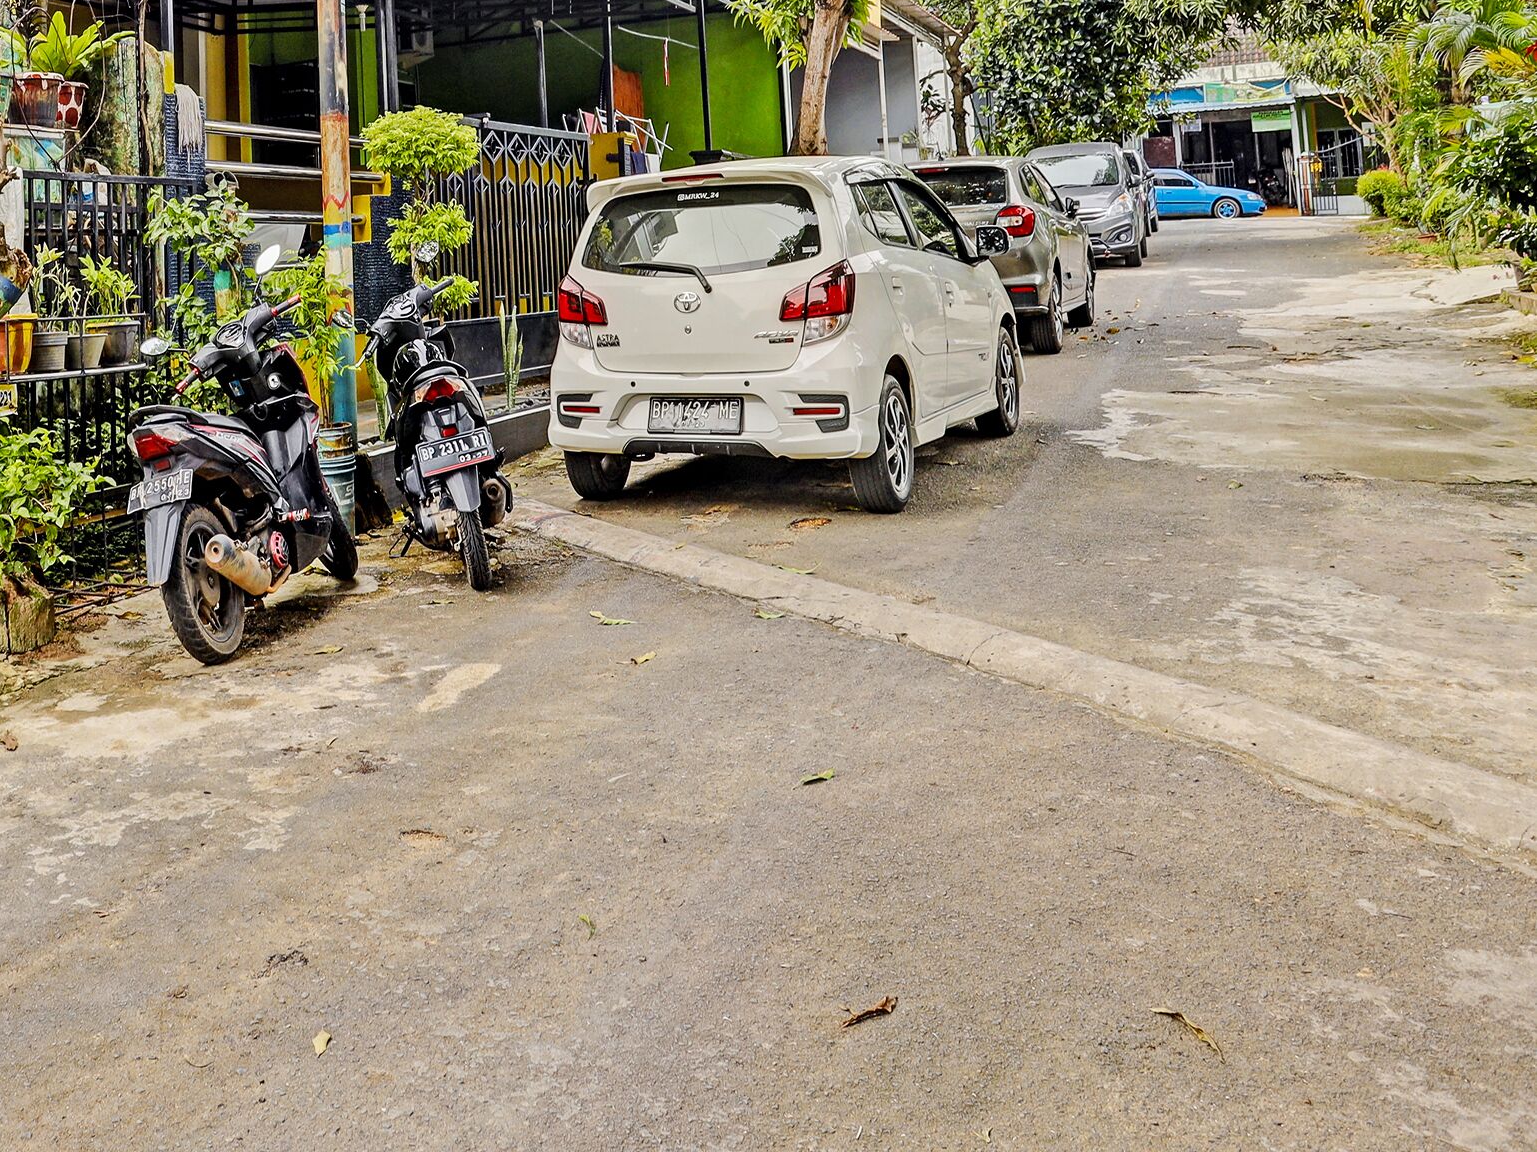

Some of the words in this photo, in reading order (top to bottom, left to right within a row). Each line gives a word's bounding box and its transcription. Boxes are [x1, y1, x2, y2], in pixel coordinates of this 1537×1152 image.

[597, 334, 620, 342] ASTRA
[652, 401, 669, 419] BP
[718, 401, 739, 419] ME
[420, 447, 435, 461] BP
[146, 475, 173, 494] 2550
